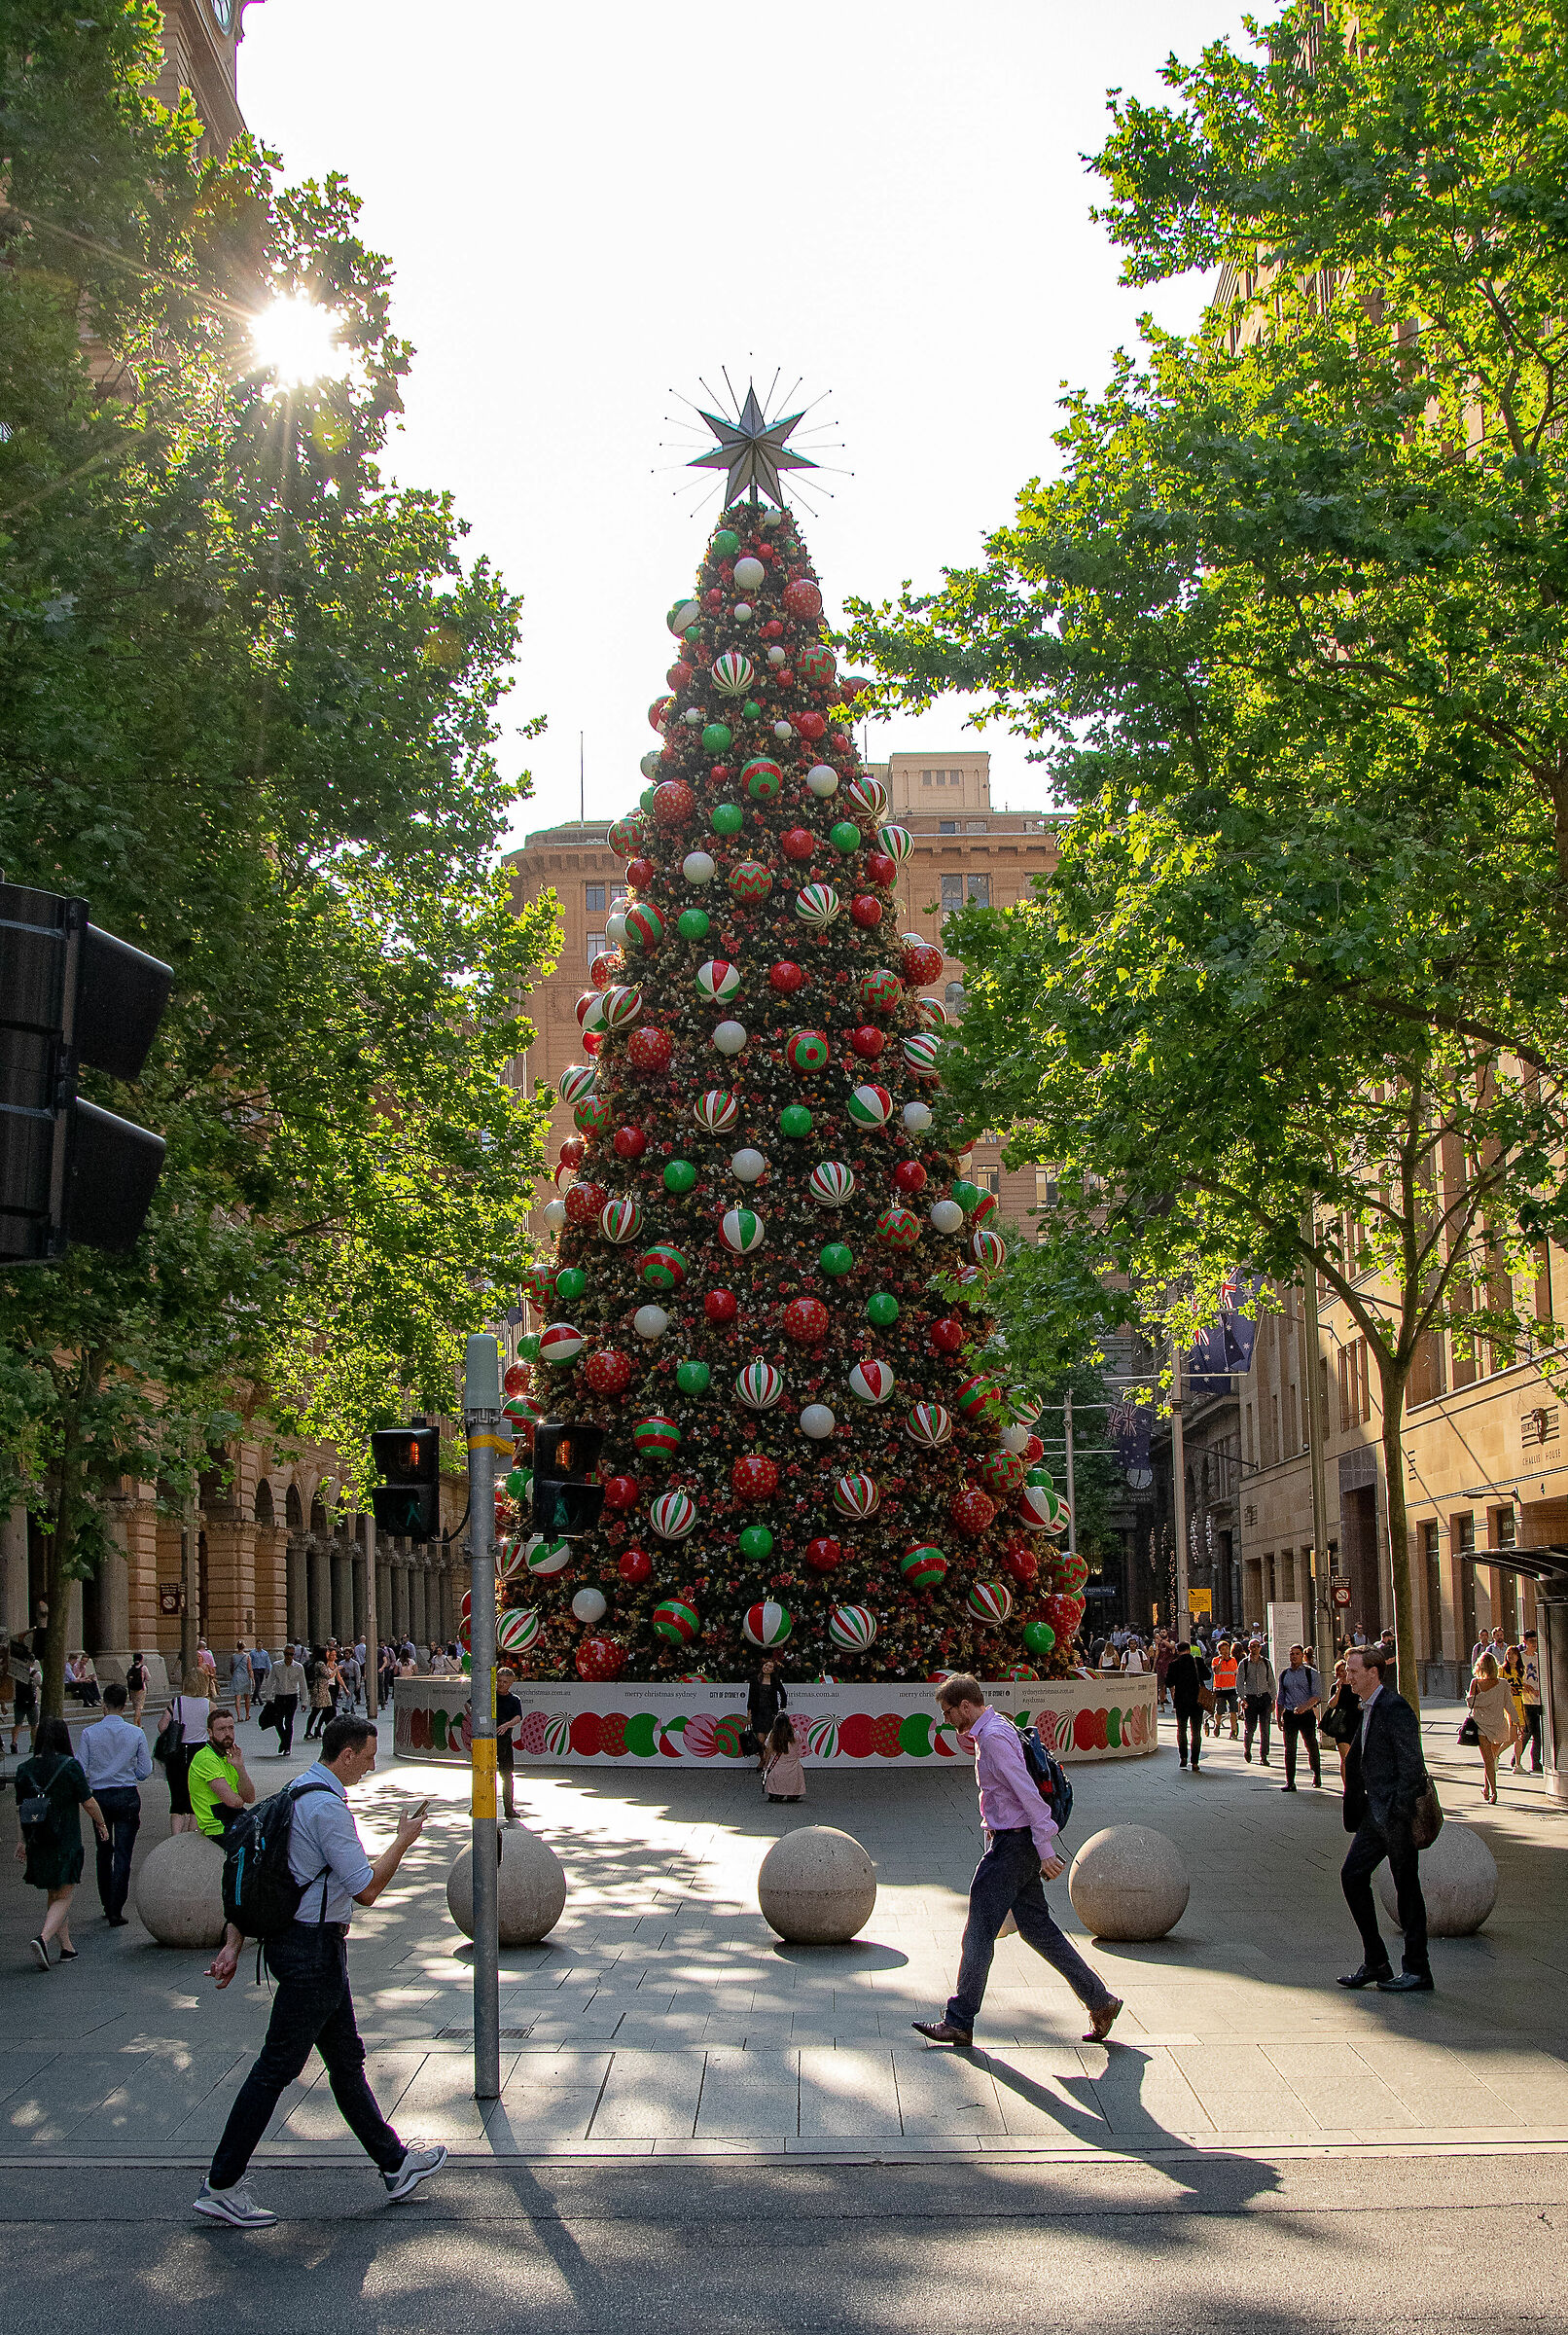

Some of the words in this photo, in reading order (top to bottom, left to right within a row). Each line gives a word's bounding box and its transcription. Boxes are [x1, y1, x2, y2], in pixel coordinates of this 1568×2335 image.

[1522, 1454, 1541, 1466] CHALLIS
[1545, 1448, 1561, 1461] HOUSE
[675, 1690, 697, 1699] sydney
